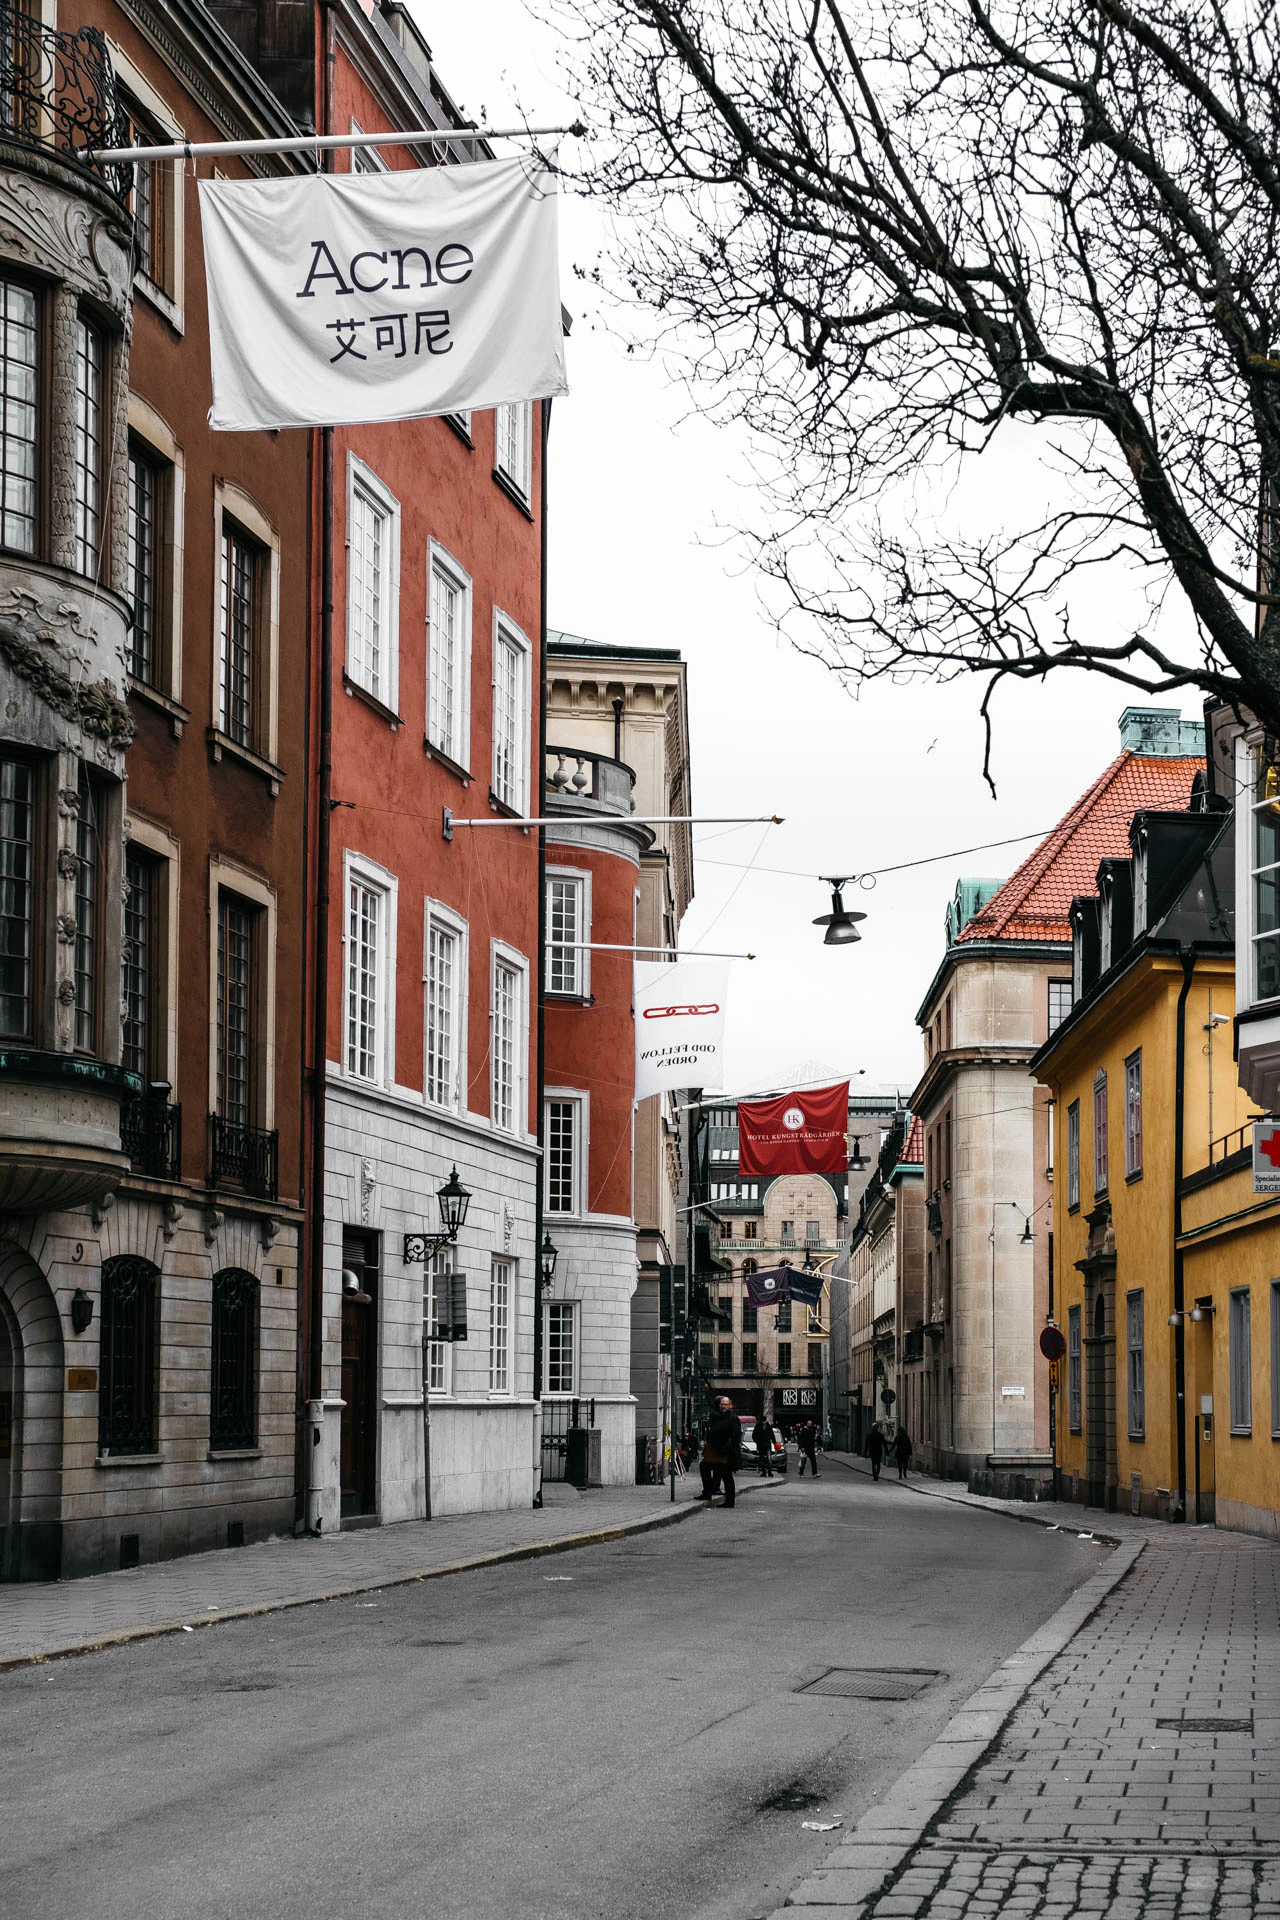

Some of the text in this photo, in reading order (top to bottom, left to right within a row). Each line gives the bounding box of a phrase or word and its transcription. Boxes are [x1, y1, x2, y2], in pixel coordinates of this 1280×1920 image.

[297, 241, 473, 297] Acne
[326, 310, 454, 364] 艾可尼
[787, 1114, 801, 1124] HK
[1255, 1184, 1280, 1192] SERGE
[71, 1242, 84, 1263] 9
